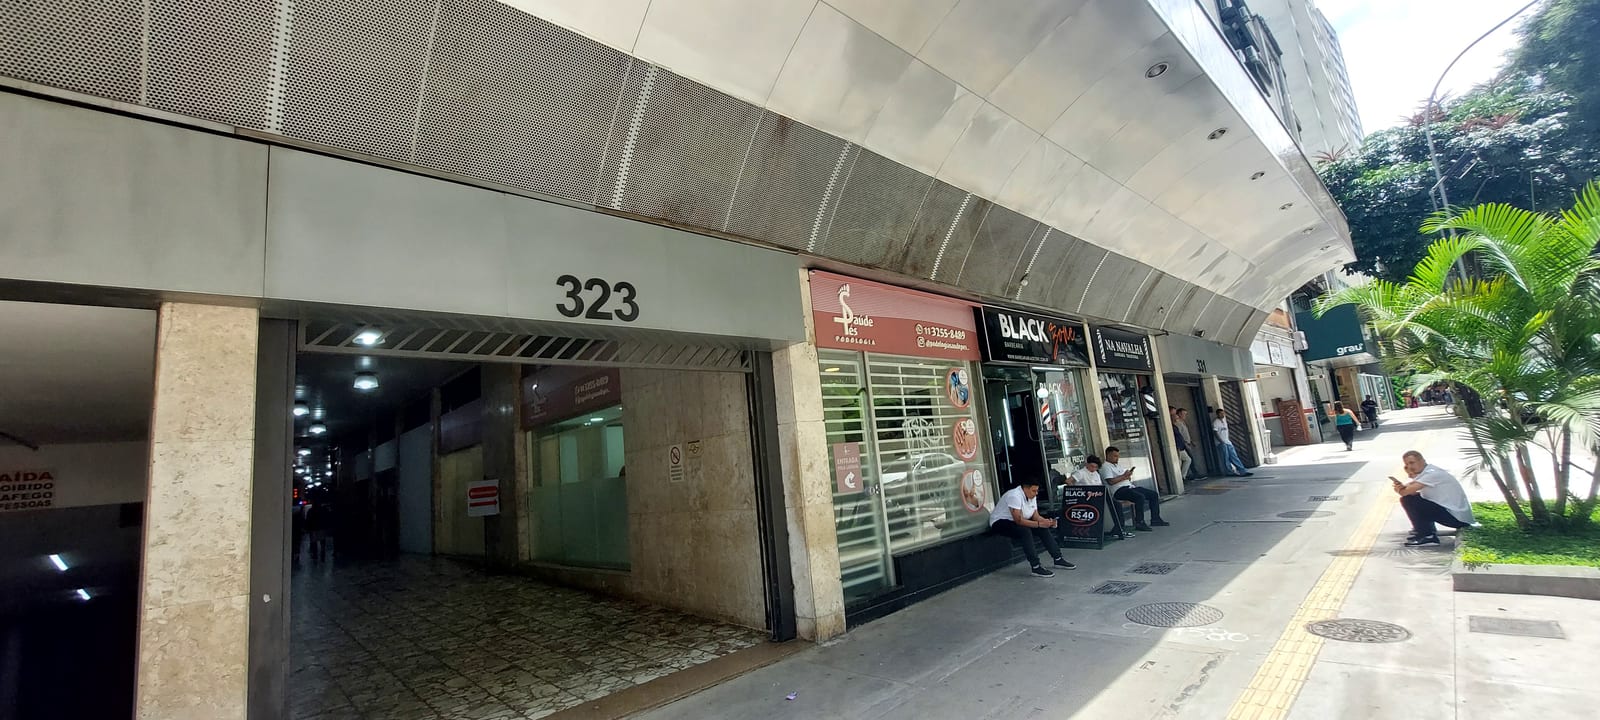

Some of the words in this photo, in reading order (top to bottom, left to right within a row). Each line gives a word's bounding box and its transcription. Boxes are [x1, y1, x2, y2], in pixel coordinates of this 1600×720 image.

[556, 274, 640, 322] 323
[924, 326, 931, 335] 11
[931, 326, 966, 340] 3255-8489
[998, 313, 1050, 343] BLACK
[835, 335, 876, 345] PODOLOGIA
[1105, 339, 1116, 351] NA
[1115, 341, 1144, 356] NAVALHA
[1336, 343, 1363, 356] grau
[0, 471, 53, 482] AÍDA
[1082, 511, 1095, 520] 40
